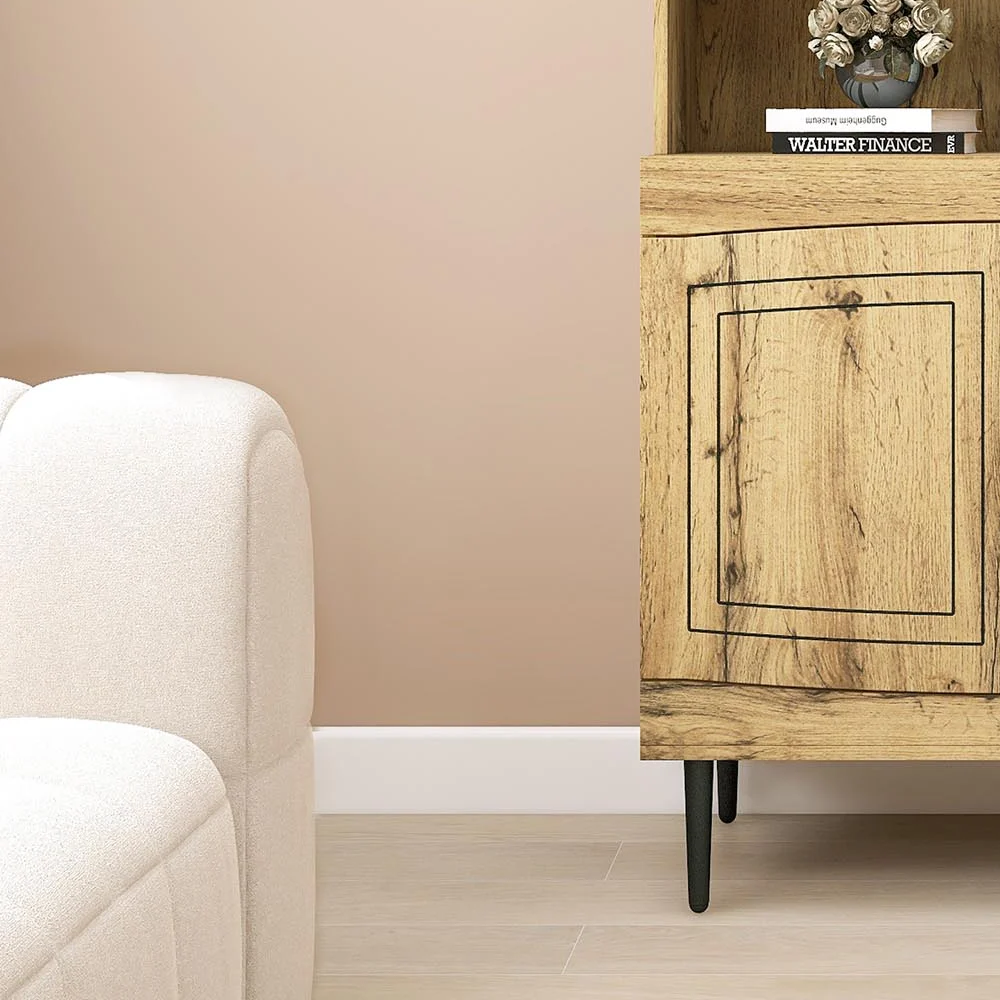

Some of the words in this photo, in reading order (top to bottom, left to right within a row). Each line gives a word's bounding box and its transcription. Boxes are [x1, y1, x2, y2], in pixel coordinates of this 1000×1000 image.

[805, 117, 838, 126] Museum
[839, 115, 887, 127] Guggenheim
[788, 137, 857, 153] WALTER
[858, 137, 932, 153] FINANCE
